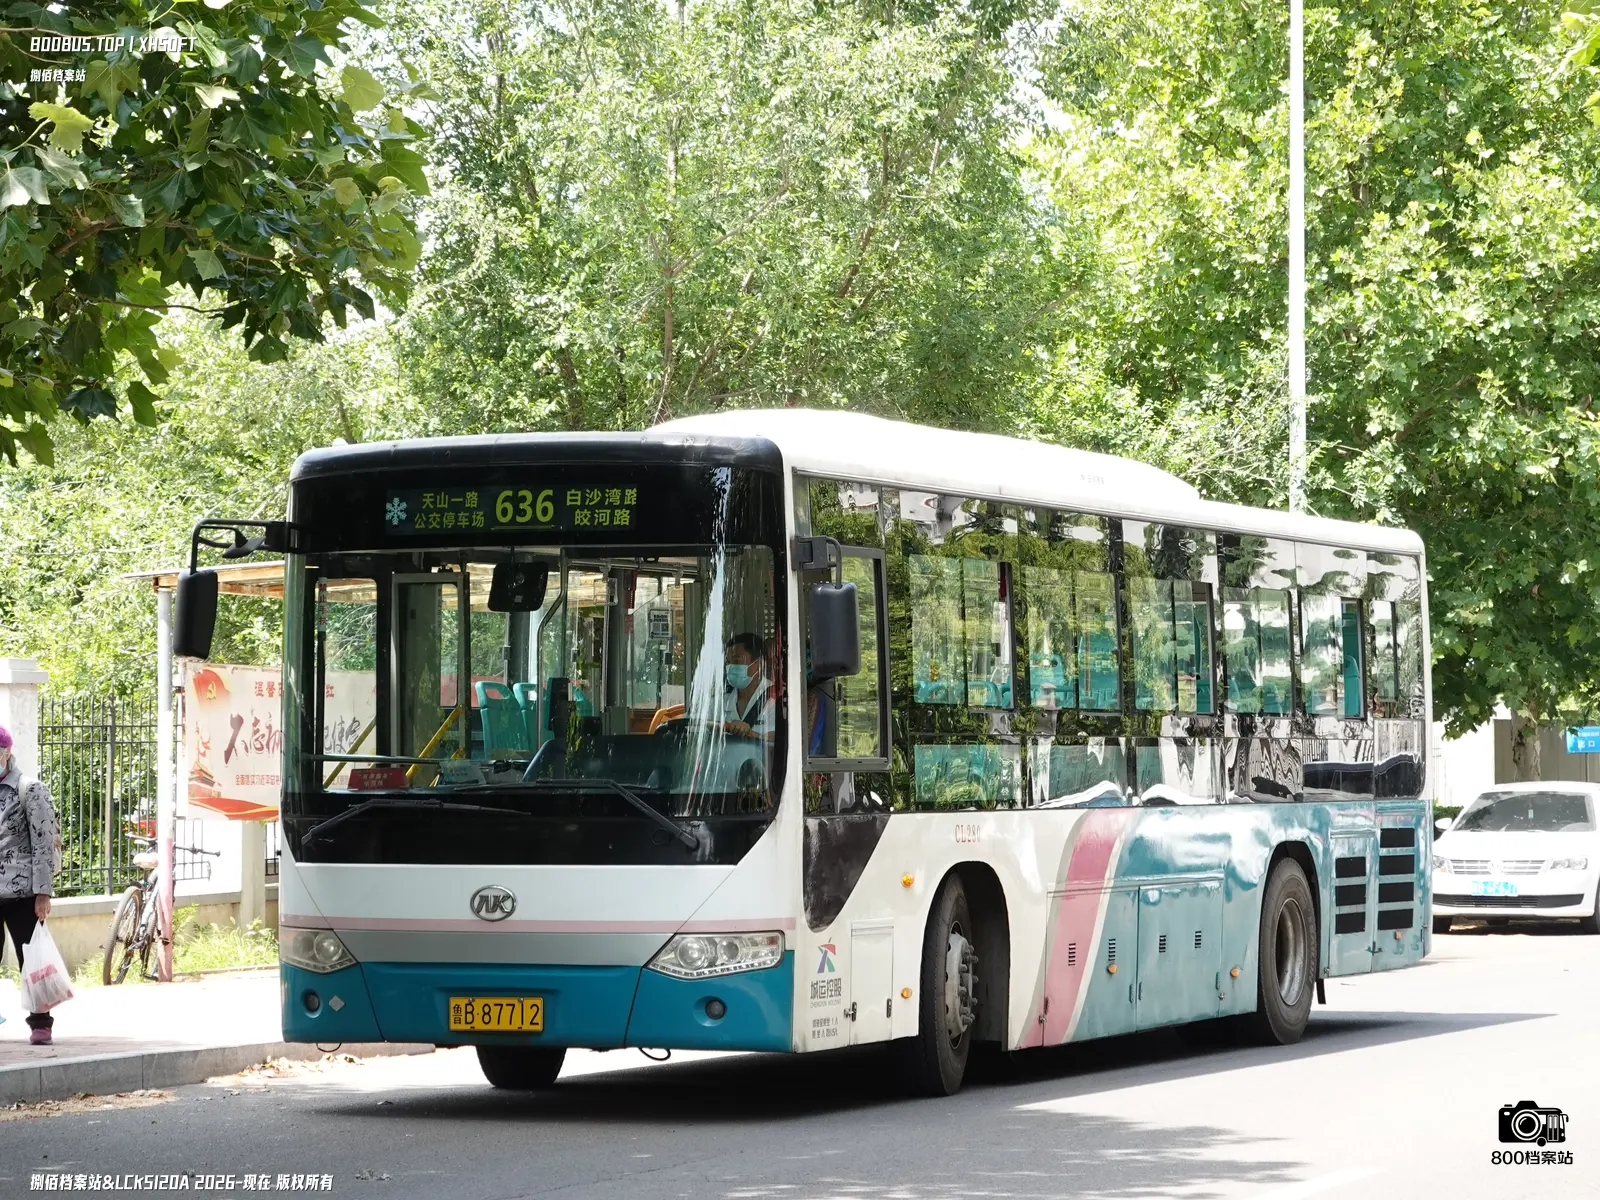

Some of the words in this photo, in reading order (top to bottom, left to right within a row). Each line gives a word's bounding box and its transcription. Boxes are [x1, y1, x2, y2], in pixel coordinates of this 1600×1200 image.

[421, 490, 479, 510] 天山一路
[495, 489, 554, 523] 636
[566, 488, 637, 506] 白沙湾路
[414, 511, 485, 529] 公交停车场
[574, 509, 631, 526] 皎河路
[810, 977, 842, 1000] 城运控股
